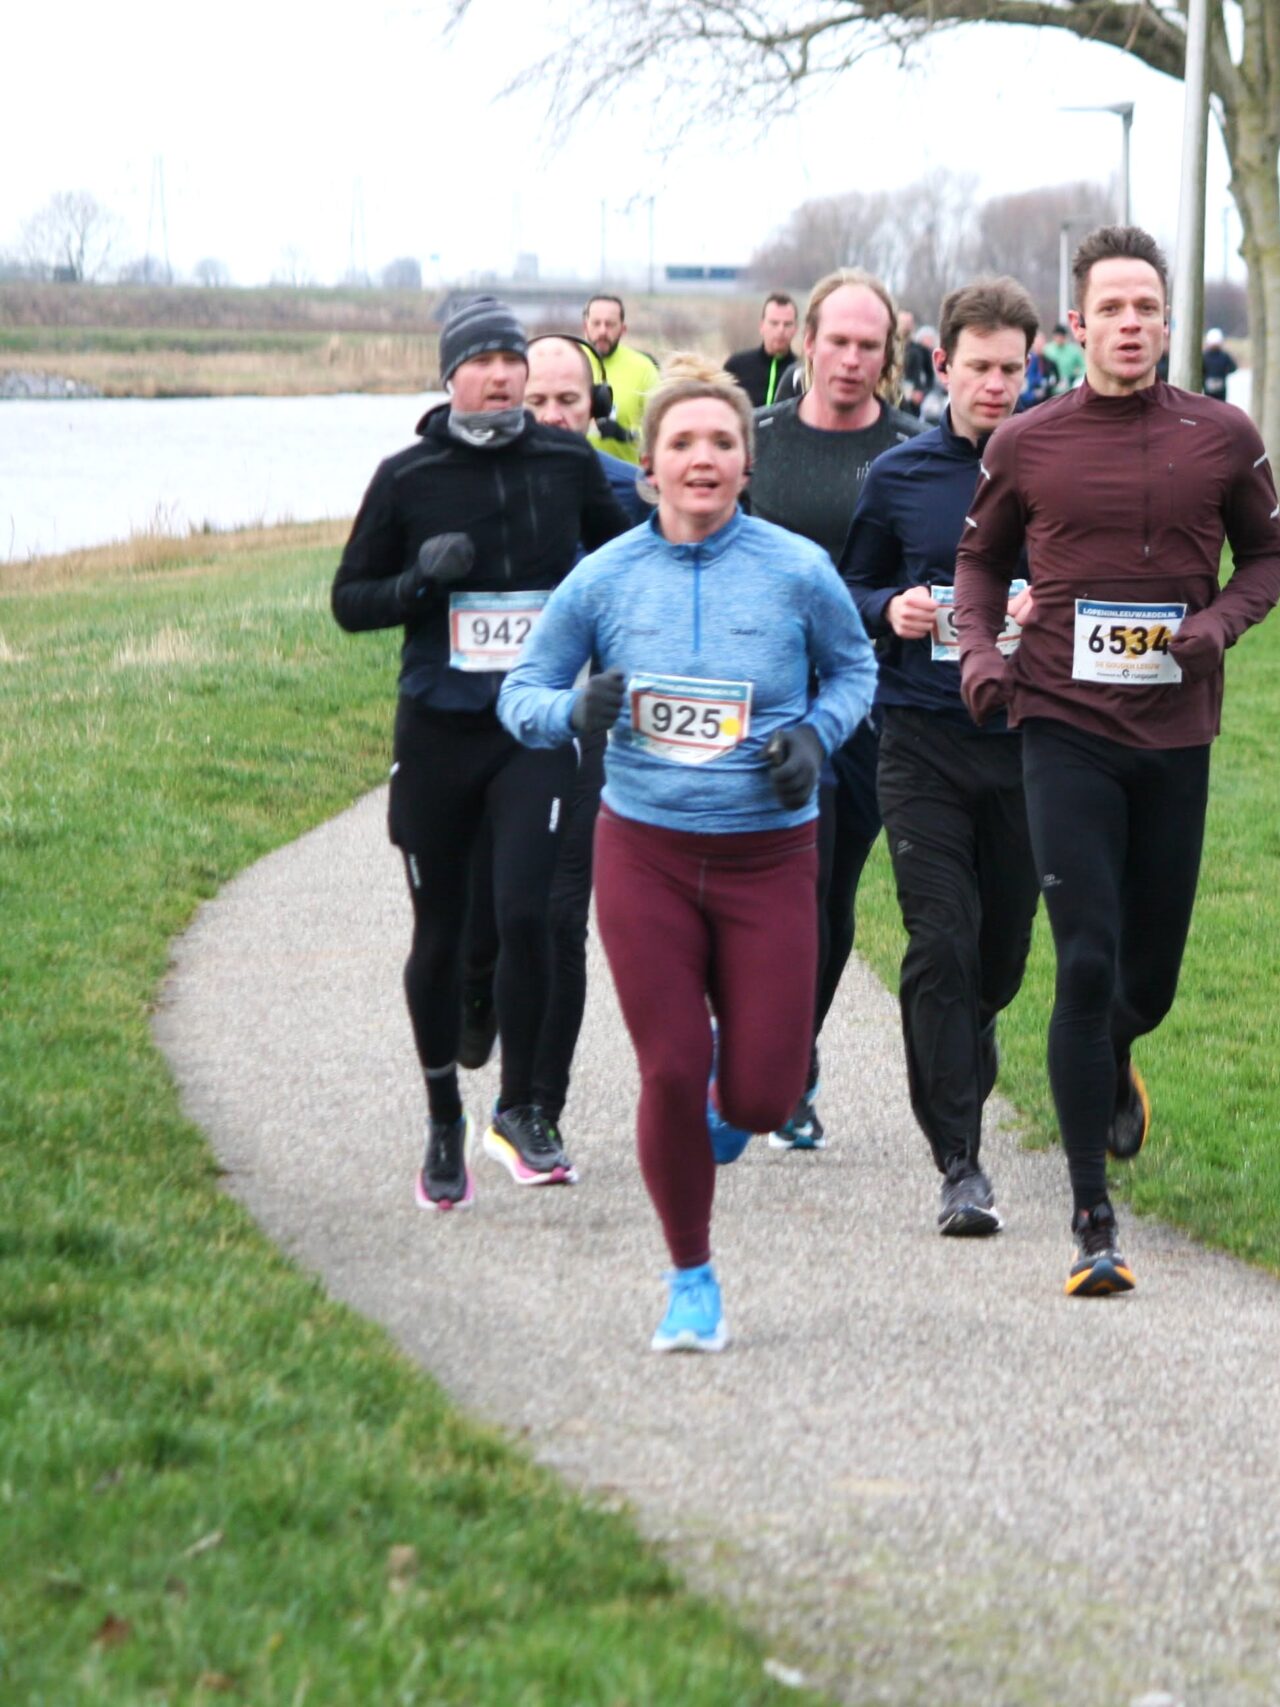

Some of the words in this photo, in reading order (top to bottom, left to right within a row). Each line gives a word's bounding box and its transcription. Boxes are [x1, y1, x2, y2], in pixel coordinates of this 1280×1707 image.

[471, 616, 533, 645] 942
[1088, 624, 1169, 656] 6534
[651, 702, 721, 739] 925
